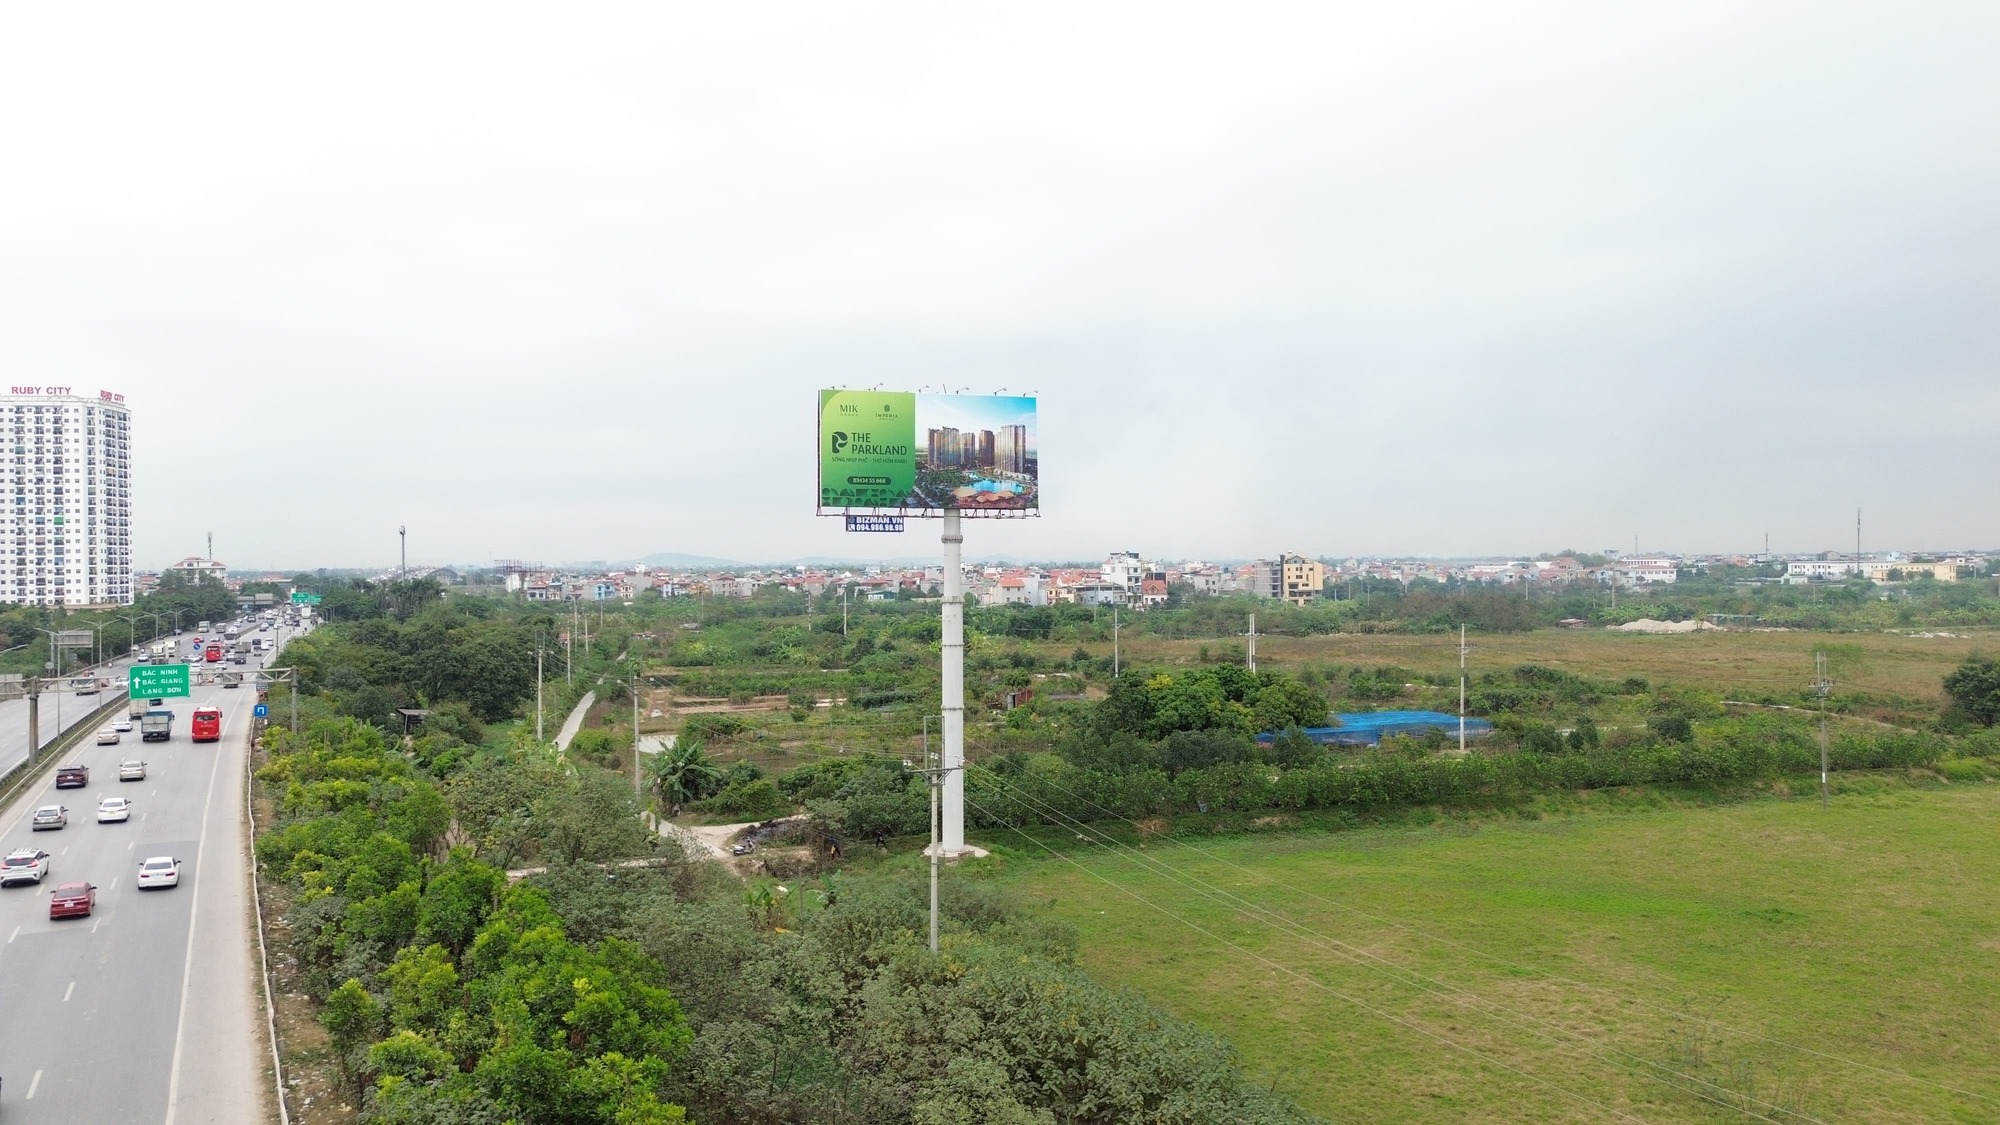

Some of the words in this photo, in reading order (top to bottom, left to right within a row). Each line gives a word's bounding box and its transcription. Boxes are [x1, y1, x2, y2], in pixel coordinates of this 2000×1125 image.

[11, 386, 41, 395] RUBY
[46, 386, 71, 395] CITY
[114, 393, 124, 402] CITY
[840, 404, 858, 413] MIK
[851, 432, 871, 443] THE
[851, 444, 907, 456] PARKLAND
[856, 516, 903, 524] BIZMAN.VN
